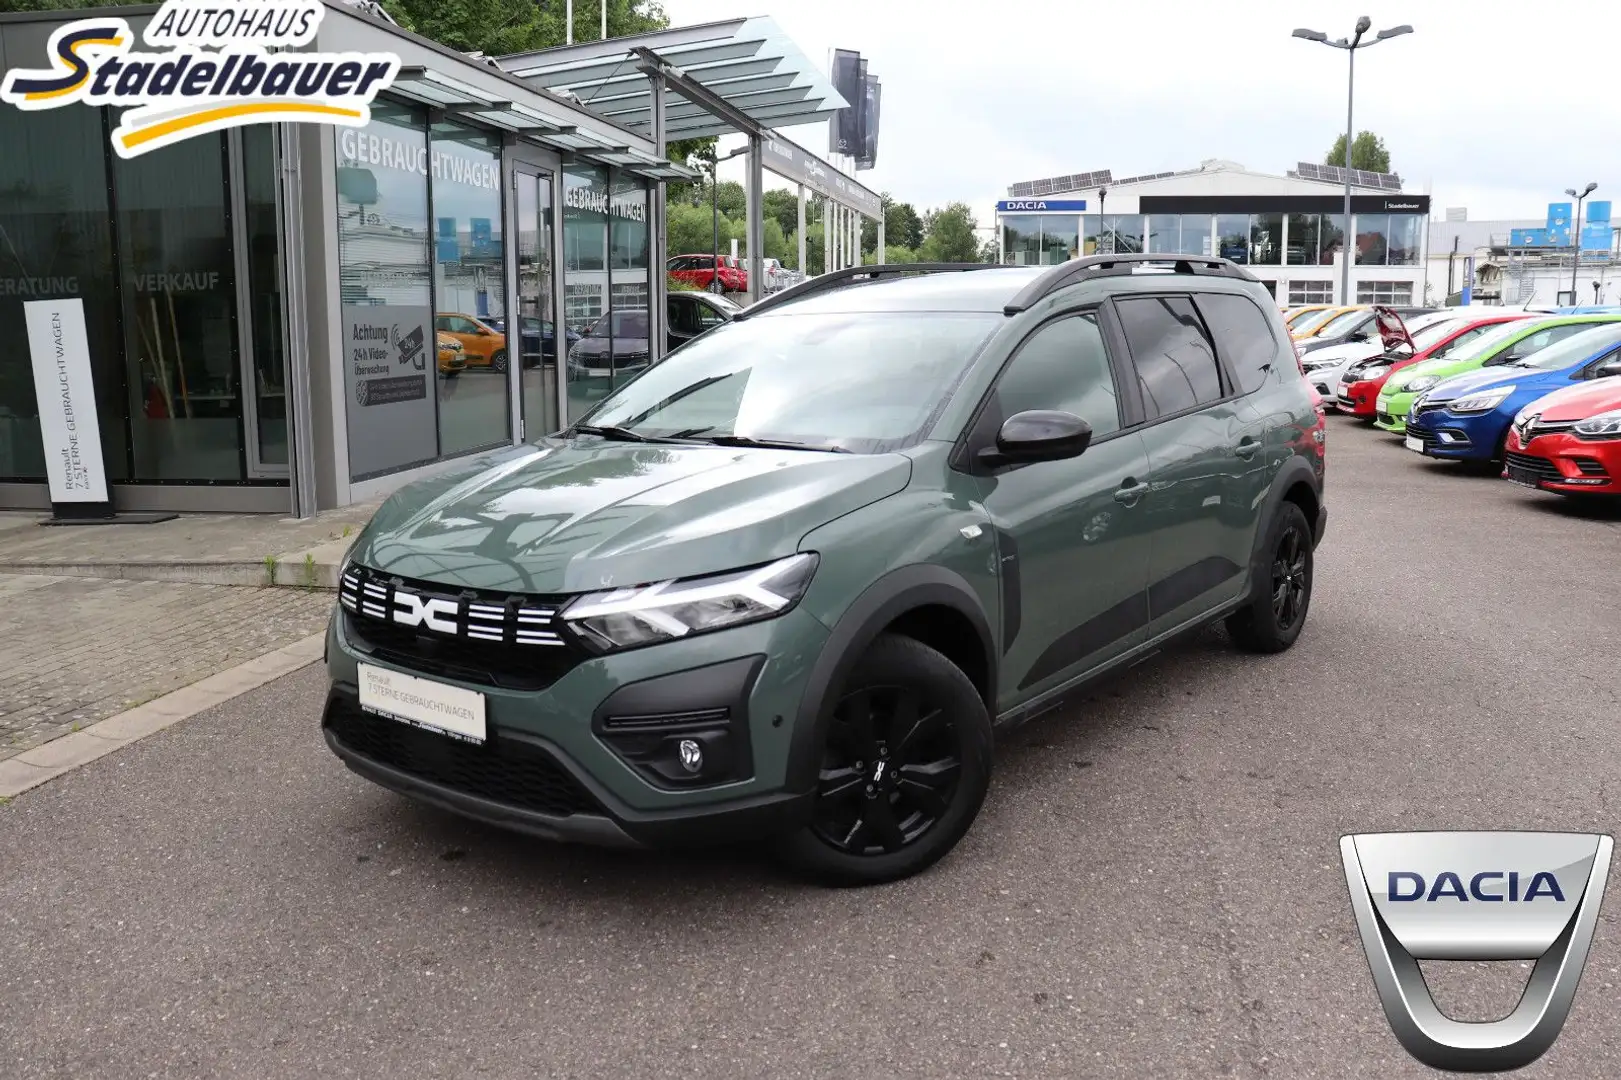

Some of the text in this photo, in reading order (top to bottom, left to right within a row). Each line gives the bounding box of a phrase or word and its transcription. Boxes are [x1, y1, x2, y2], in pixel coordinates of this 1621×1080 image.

[341, 129, 499, 191] GEBRAUCHTWAGEN
[566, 186, 646, 222] GEBRAUCHTWAGEN
[1006, 201, 1047, 209] DACIA
[133, 271, 219, 292] VERKAUF
[353, 324, 388, 344] Achtung
[368, 347, 388, 360] Video-
[52, 312, 77, 431] GEBRAUCHTWAGEN
[354, 363, 390, 375] Überwachung
[61, 447, 74, 490] Renault
[69, 433, 83, 480] STERNE
[366, 672, 391, 687] Renault
[373, 684, 399, 701] STERNE
[400, 692, 475, 720] GEBRAUCHTWAGEN
